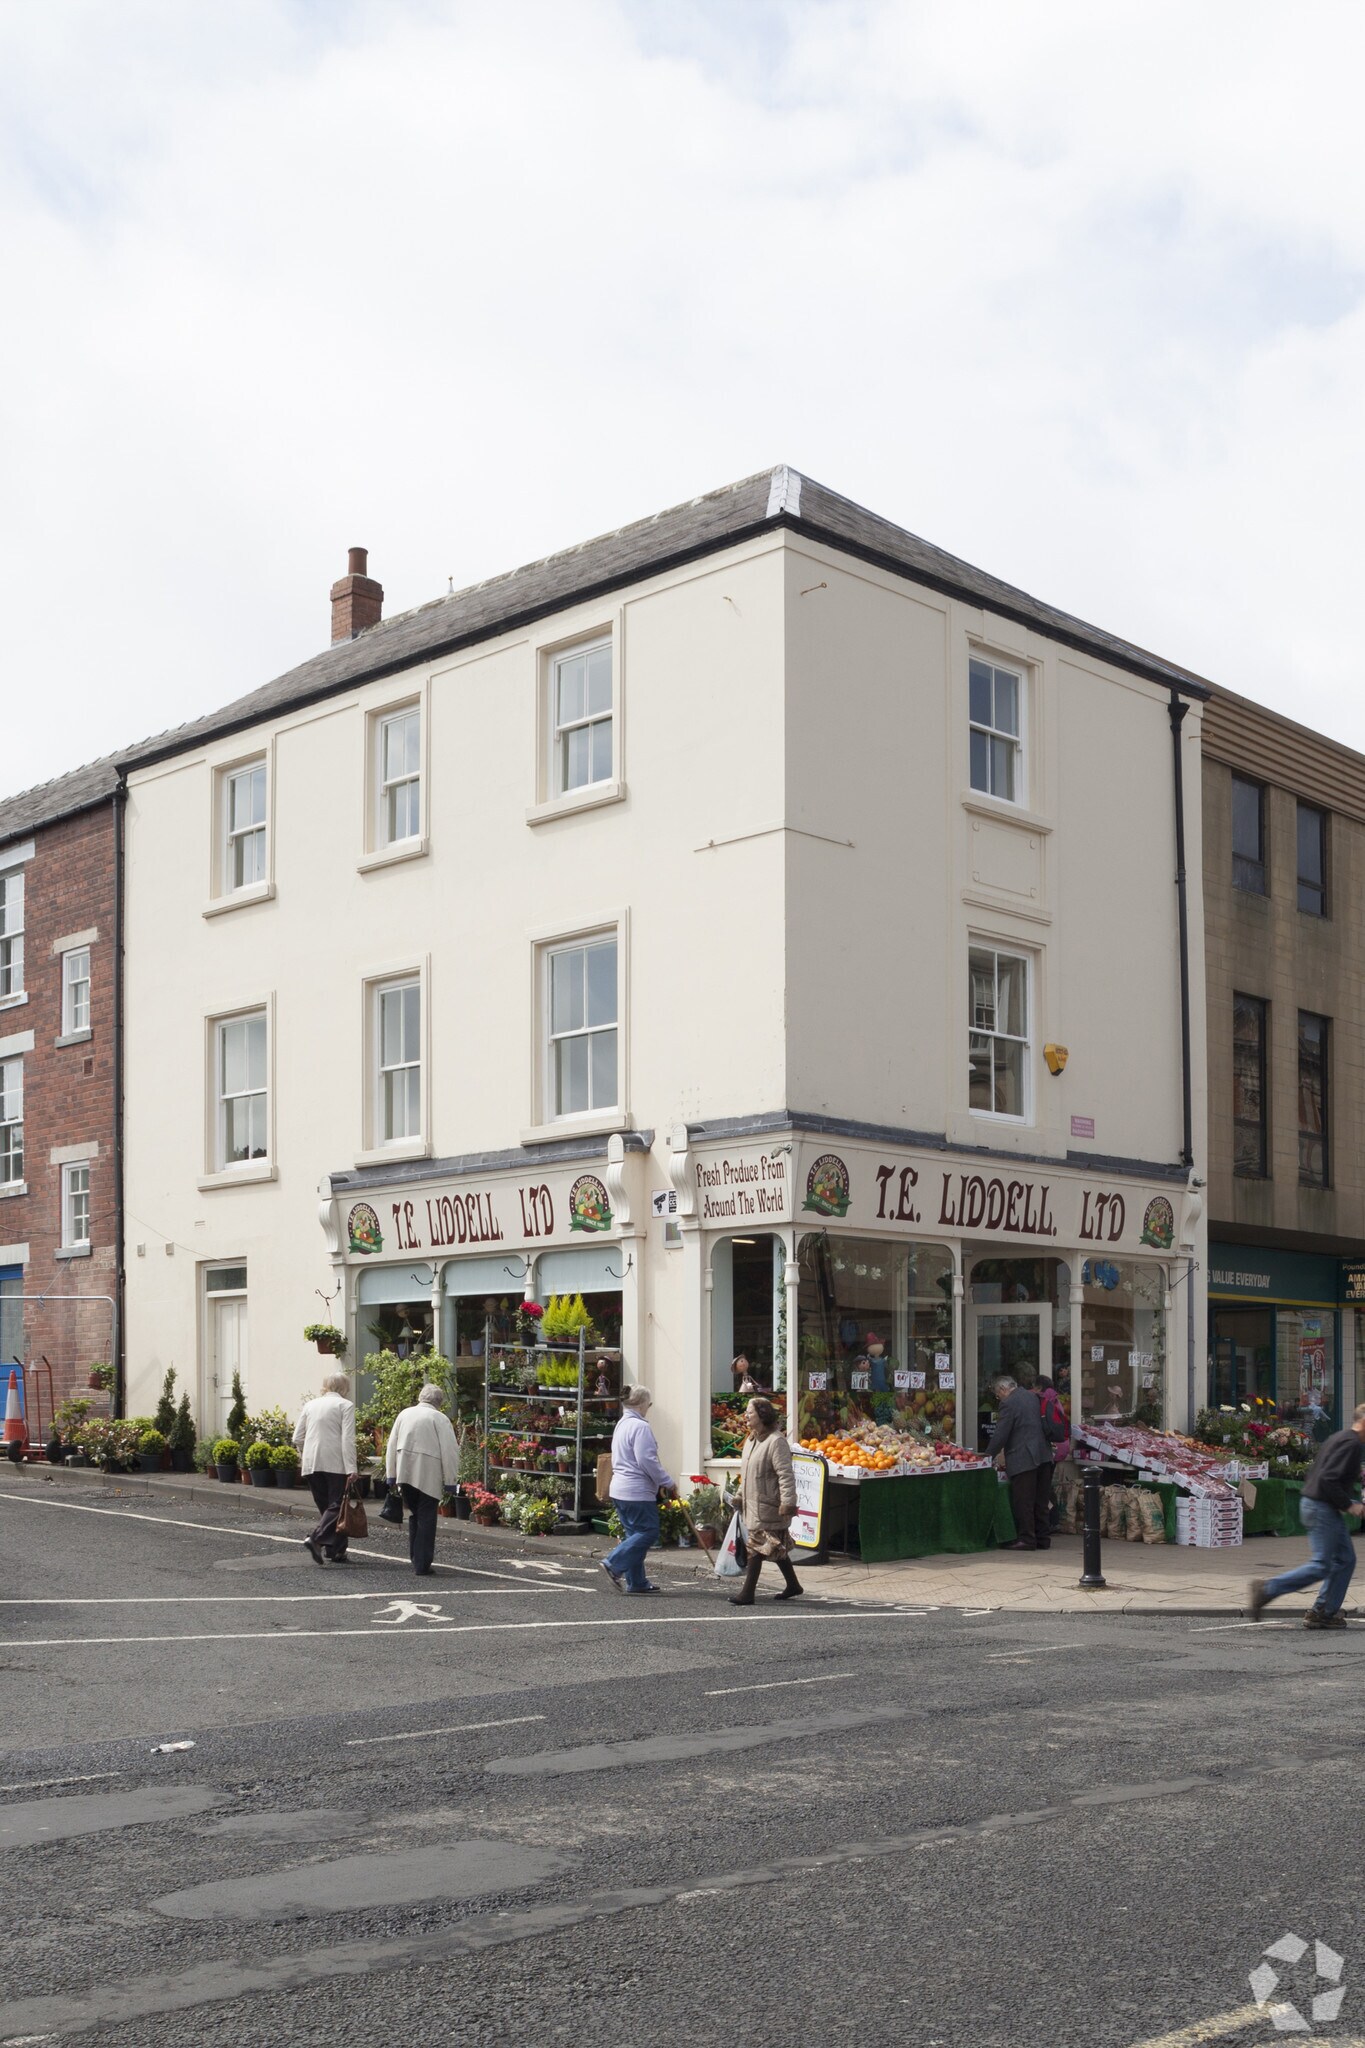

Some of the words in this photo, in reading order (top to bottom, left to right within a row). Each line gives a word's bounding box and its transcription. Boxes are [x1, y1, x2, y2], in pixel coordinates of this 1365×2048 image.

[696, 1162, 721, 1187] Fresh
[722, 1160, 759, 1185] Produce
[760, 1155, 785, 1181] From
[392, 1200, 422, 1250] T.E.
[518, 1183, 554, 1238] LTD
[703, 1192, 736, 1219] Around
[737, 1190, 755, 1215] The
[756, 1187, 784, 1213] World
[876, 1165, 921, 1223] T.E.
[1078, 1190, 1126, 1242] LTD
[1212, 1269, 1235, 1285] VALUE
[1235, 1272, 1270, 1288] EVERYDAY
[794, 1463, 820, 1477] ESIGN
[796, 1480, 811, 1491] INT
